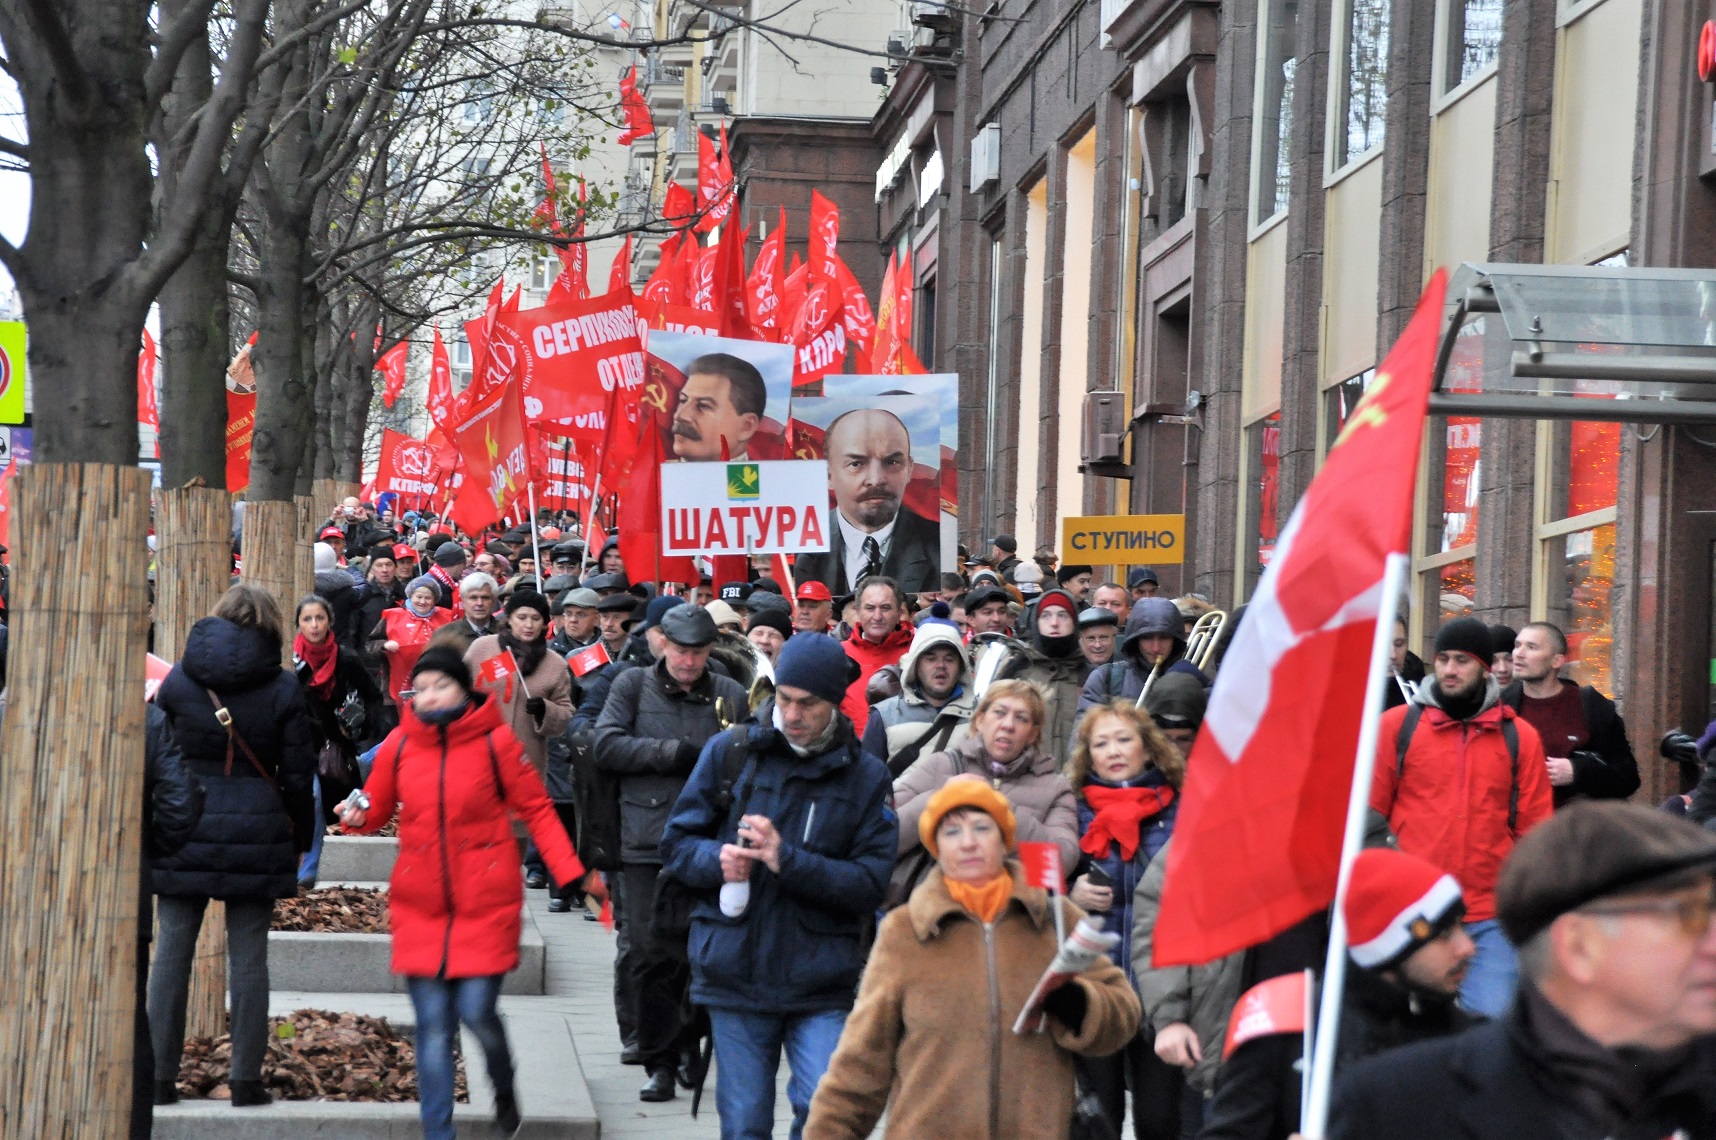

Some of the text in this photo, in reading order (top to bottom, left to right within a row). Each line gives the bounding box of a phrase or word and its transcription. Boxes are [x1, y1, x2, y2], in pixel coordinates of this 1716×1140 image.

[799, 323, 846, 374] КПРФ
[389, 476, 439, 495] КПРФ
[668, 505, 824, 550] ШАТУРА
[1071, 530, 1175, 550] СТУПИНО
[722, 586, 741, 599] FBI
